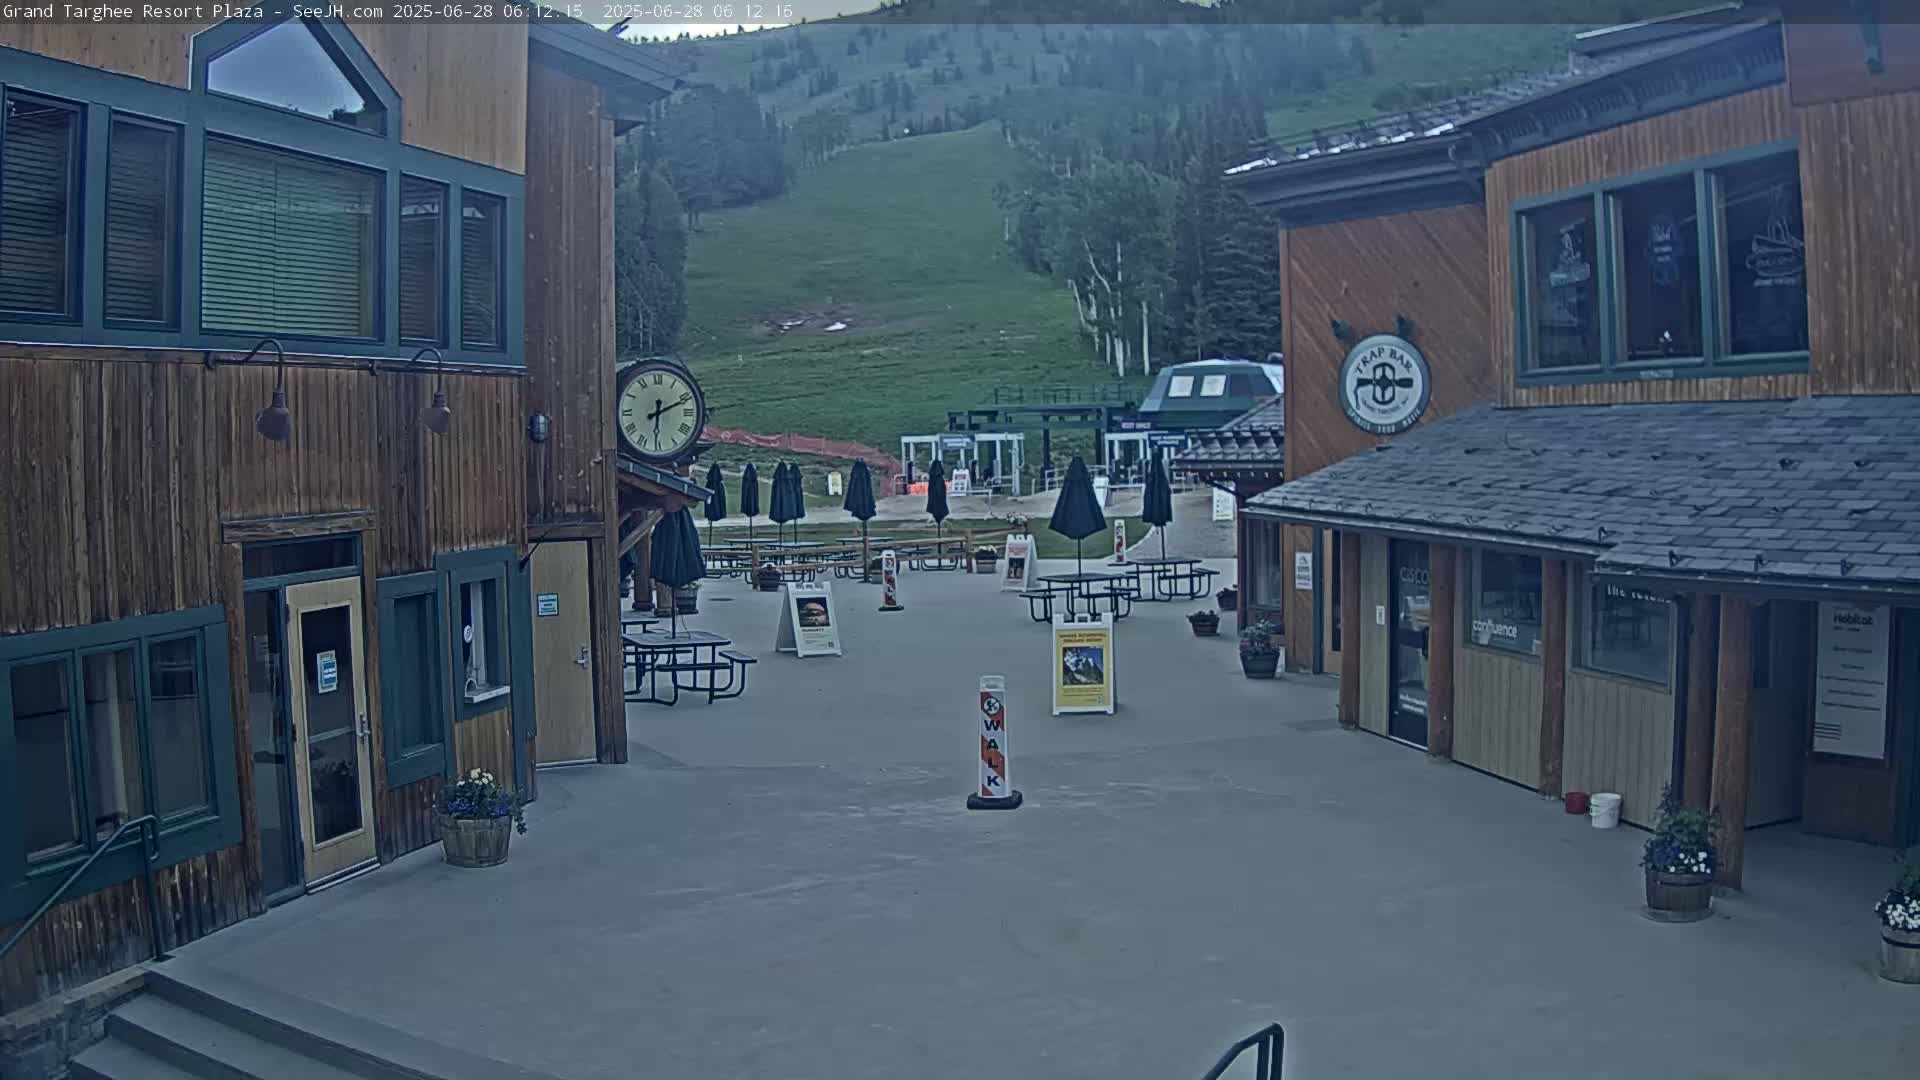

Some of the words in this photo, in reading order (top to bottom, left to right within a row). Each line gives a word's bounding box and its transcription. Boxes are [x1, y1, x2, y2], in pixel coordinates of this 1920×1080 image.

[1354, 347, 1385, 374] TRAP
[1389, 348, 1414, 374] BAR
[984, 719, 1001, 787] WALK
